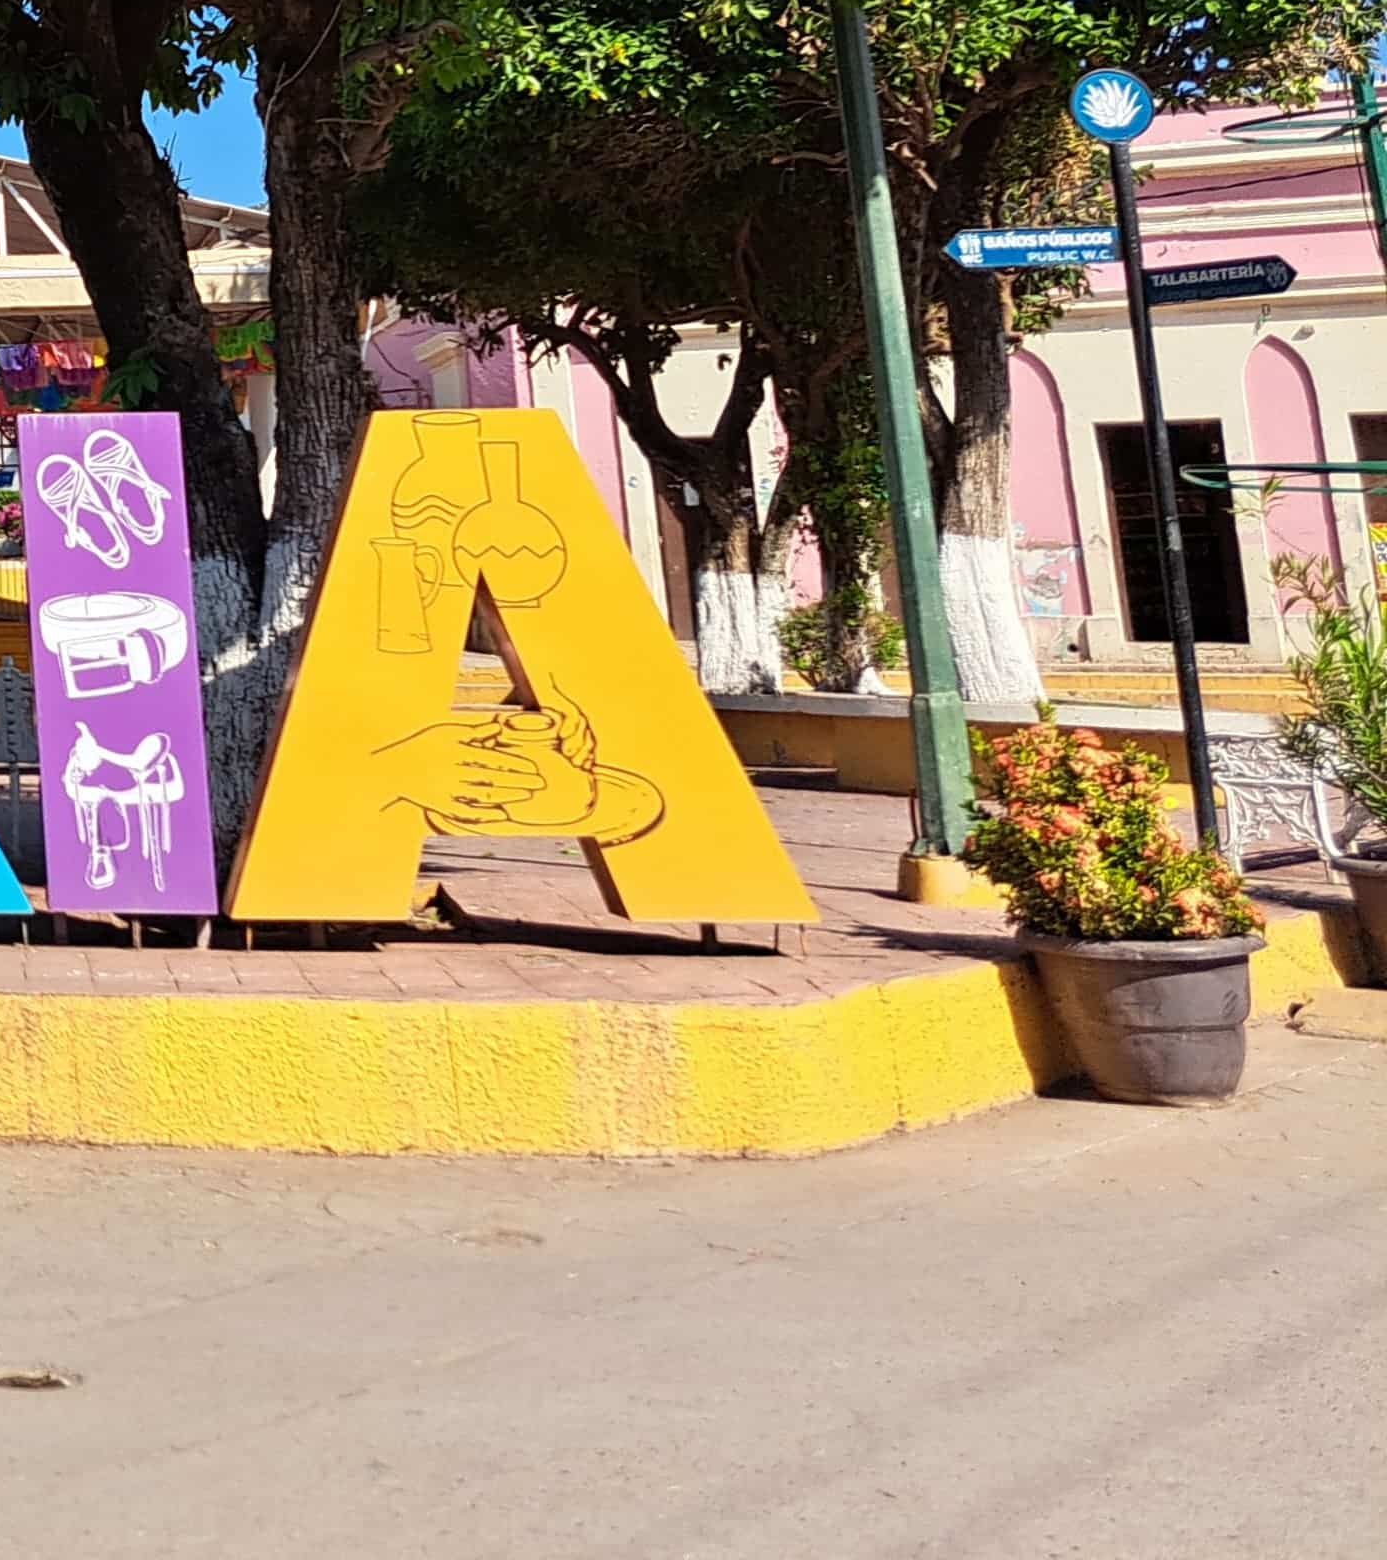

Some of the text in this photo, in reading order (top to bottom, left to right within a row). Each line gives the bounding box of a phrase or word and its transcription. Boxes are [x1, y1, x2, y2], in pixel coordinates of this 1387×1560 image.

[983, 230, 1112, 249] BAÑOS PÚBLICOS
[959, 254, 984, 264] WC
[1027, 249, 1115, 262] PUBLIC W.C.
[1151, 262, 1265, 287] TALABARTERÍA
